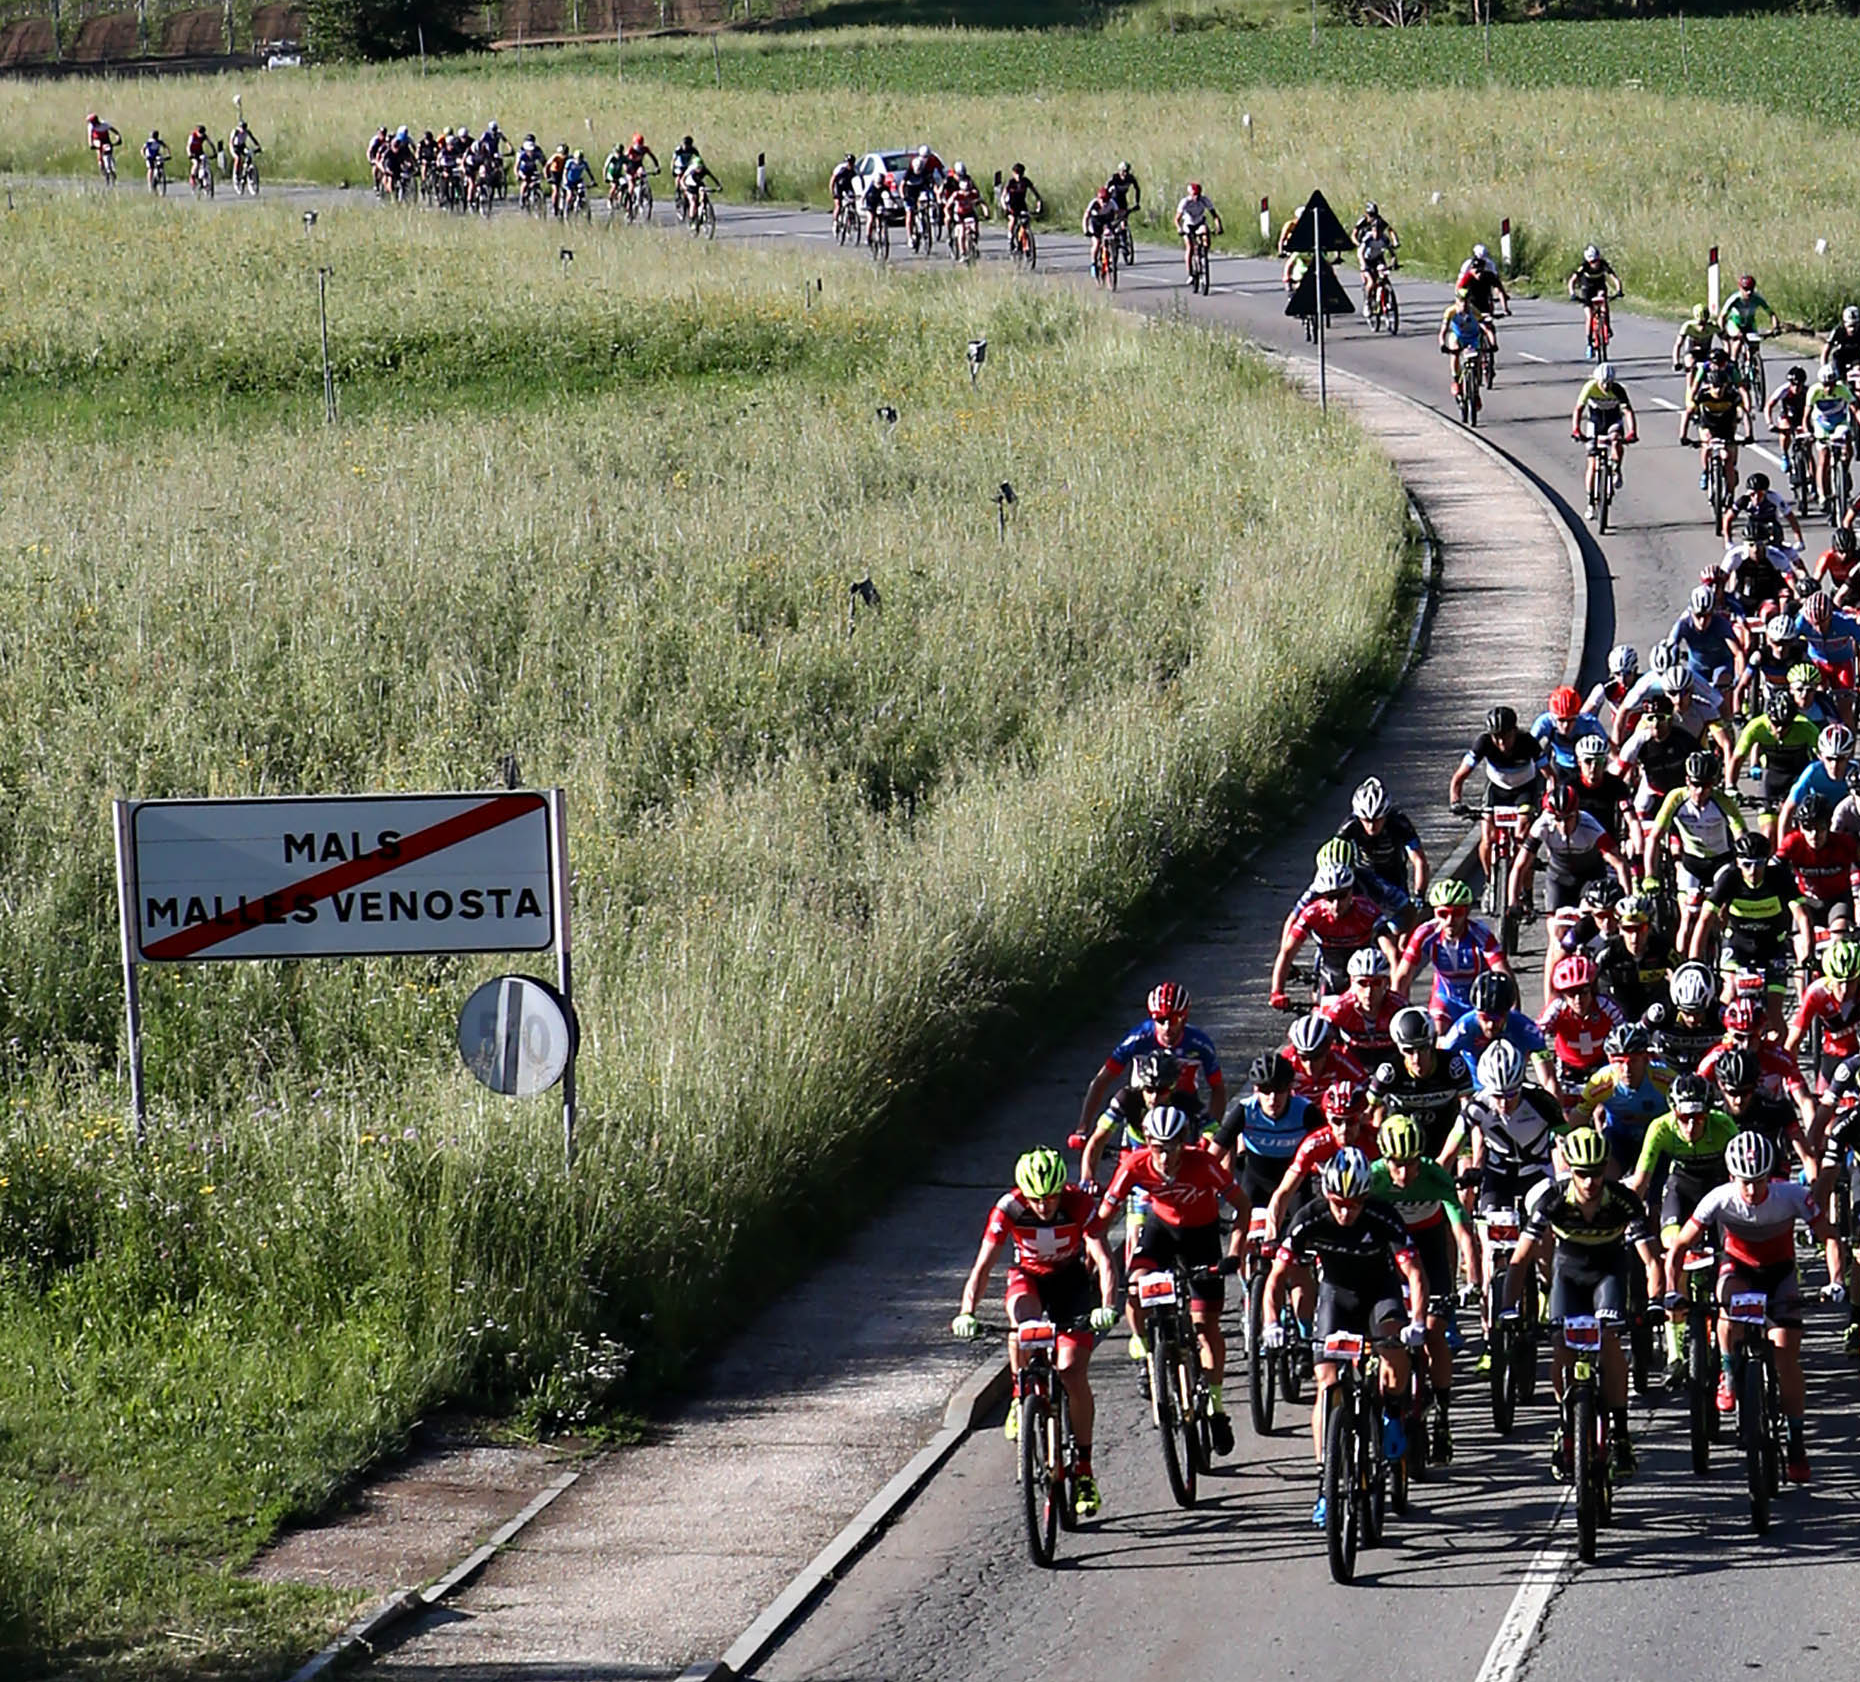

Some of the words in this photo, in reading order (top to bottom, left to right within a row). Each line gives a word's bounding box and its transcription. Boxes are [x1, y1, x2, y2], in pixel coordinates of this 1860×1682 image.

[283, 830, 403, 864] MALS
[147, 894, 319, 929] MALLES
[331, 887, 543, 924] VENOSTA
